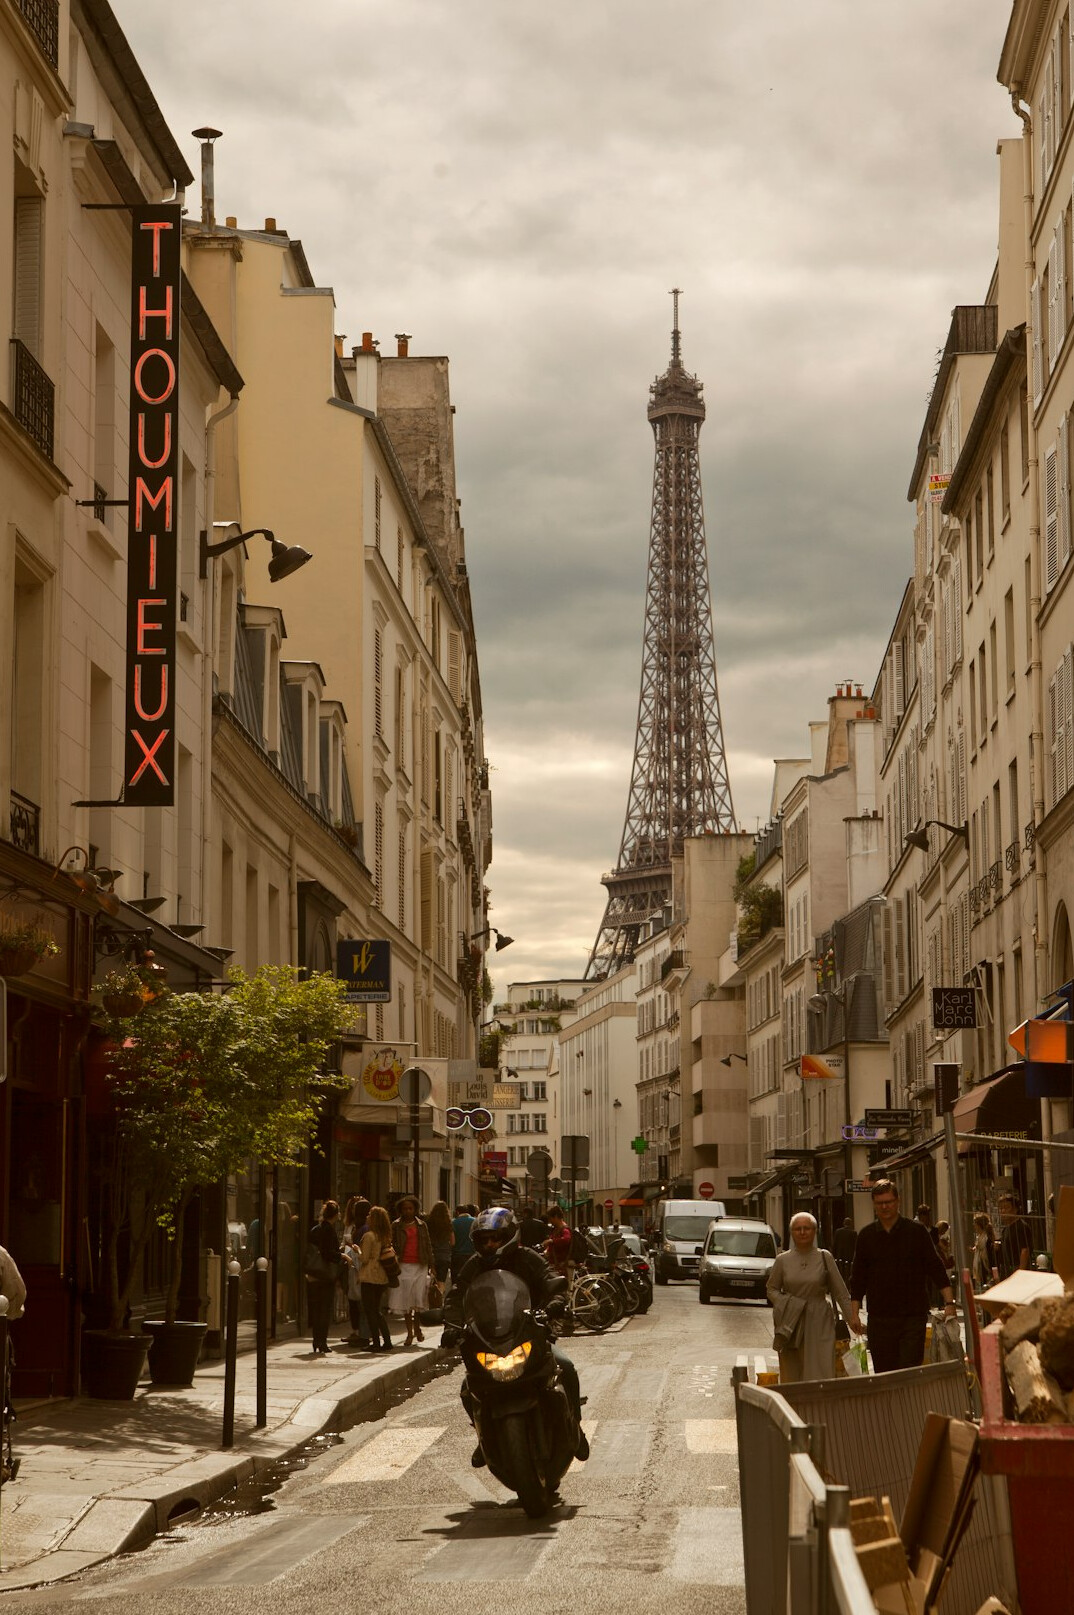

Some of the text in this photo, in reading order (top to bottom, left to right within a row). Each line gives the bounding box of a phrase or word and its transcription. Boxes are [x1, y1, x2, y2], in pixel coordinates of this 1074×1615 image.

[130, 222, 176, 787] THOUMIEUX
[347, 980, 385, 989] ATERMAN
[941, 991, 974, 1004] Karl
[935, 1002, 973, 1014] Marc
[936, 1012, 974, 1025] John
[466, 1081, 487, 1090] Louis
[493, 1084, 520, 1094] LANGERIE
[466, 1089, 488, 1099] David
